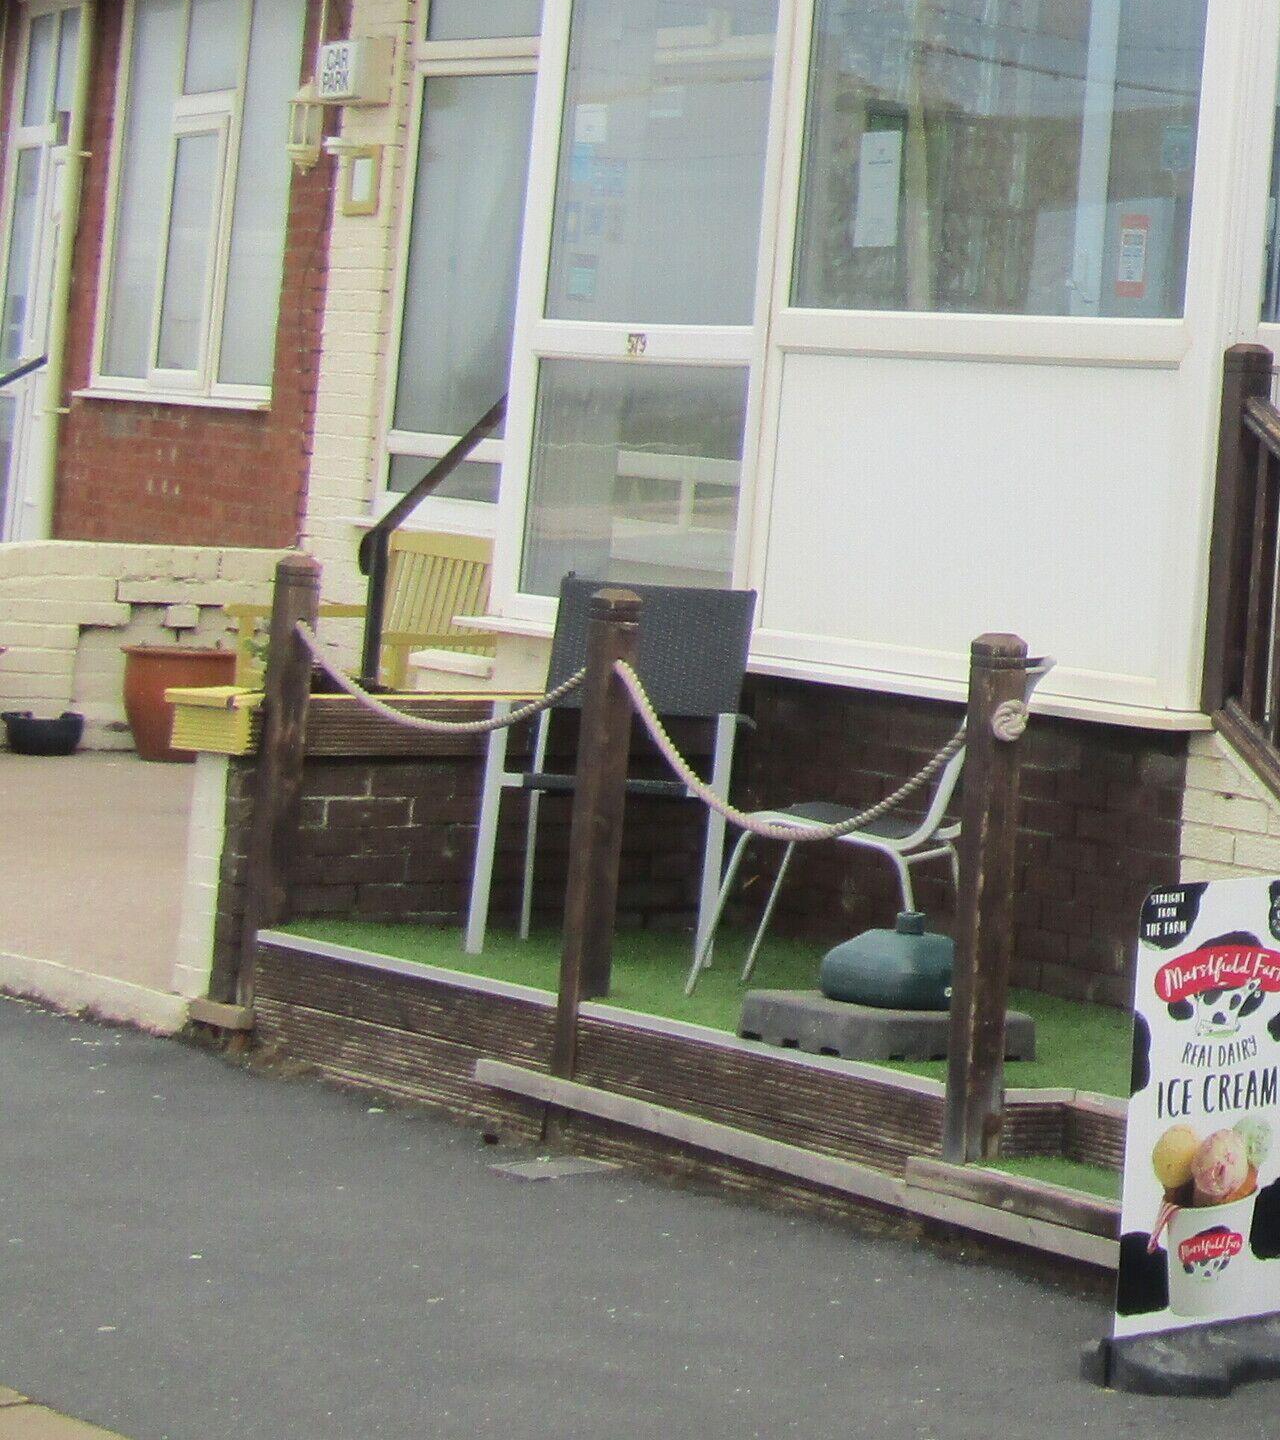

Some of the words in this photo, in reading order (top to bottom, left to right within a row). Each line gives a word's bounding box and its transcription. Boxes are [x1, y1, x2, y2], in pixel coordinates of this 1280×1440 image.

[1164, 951, 1251, 998] Marshfield
[1181, 1041, 1213, 1068] REAL
[1217, 1034, 1258, 1068] DAIRY
[1157, 1078, 1193, 1120] ICE
[1202, 1065, 1278, 1114] CREAM
